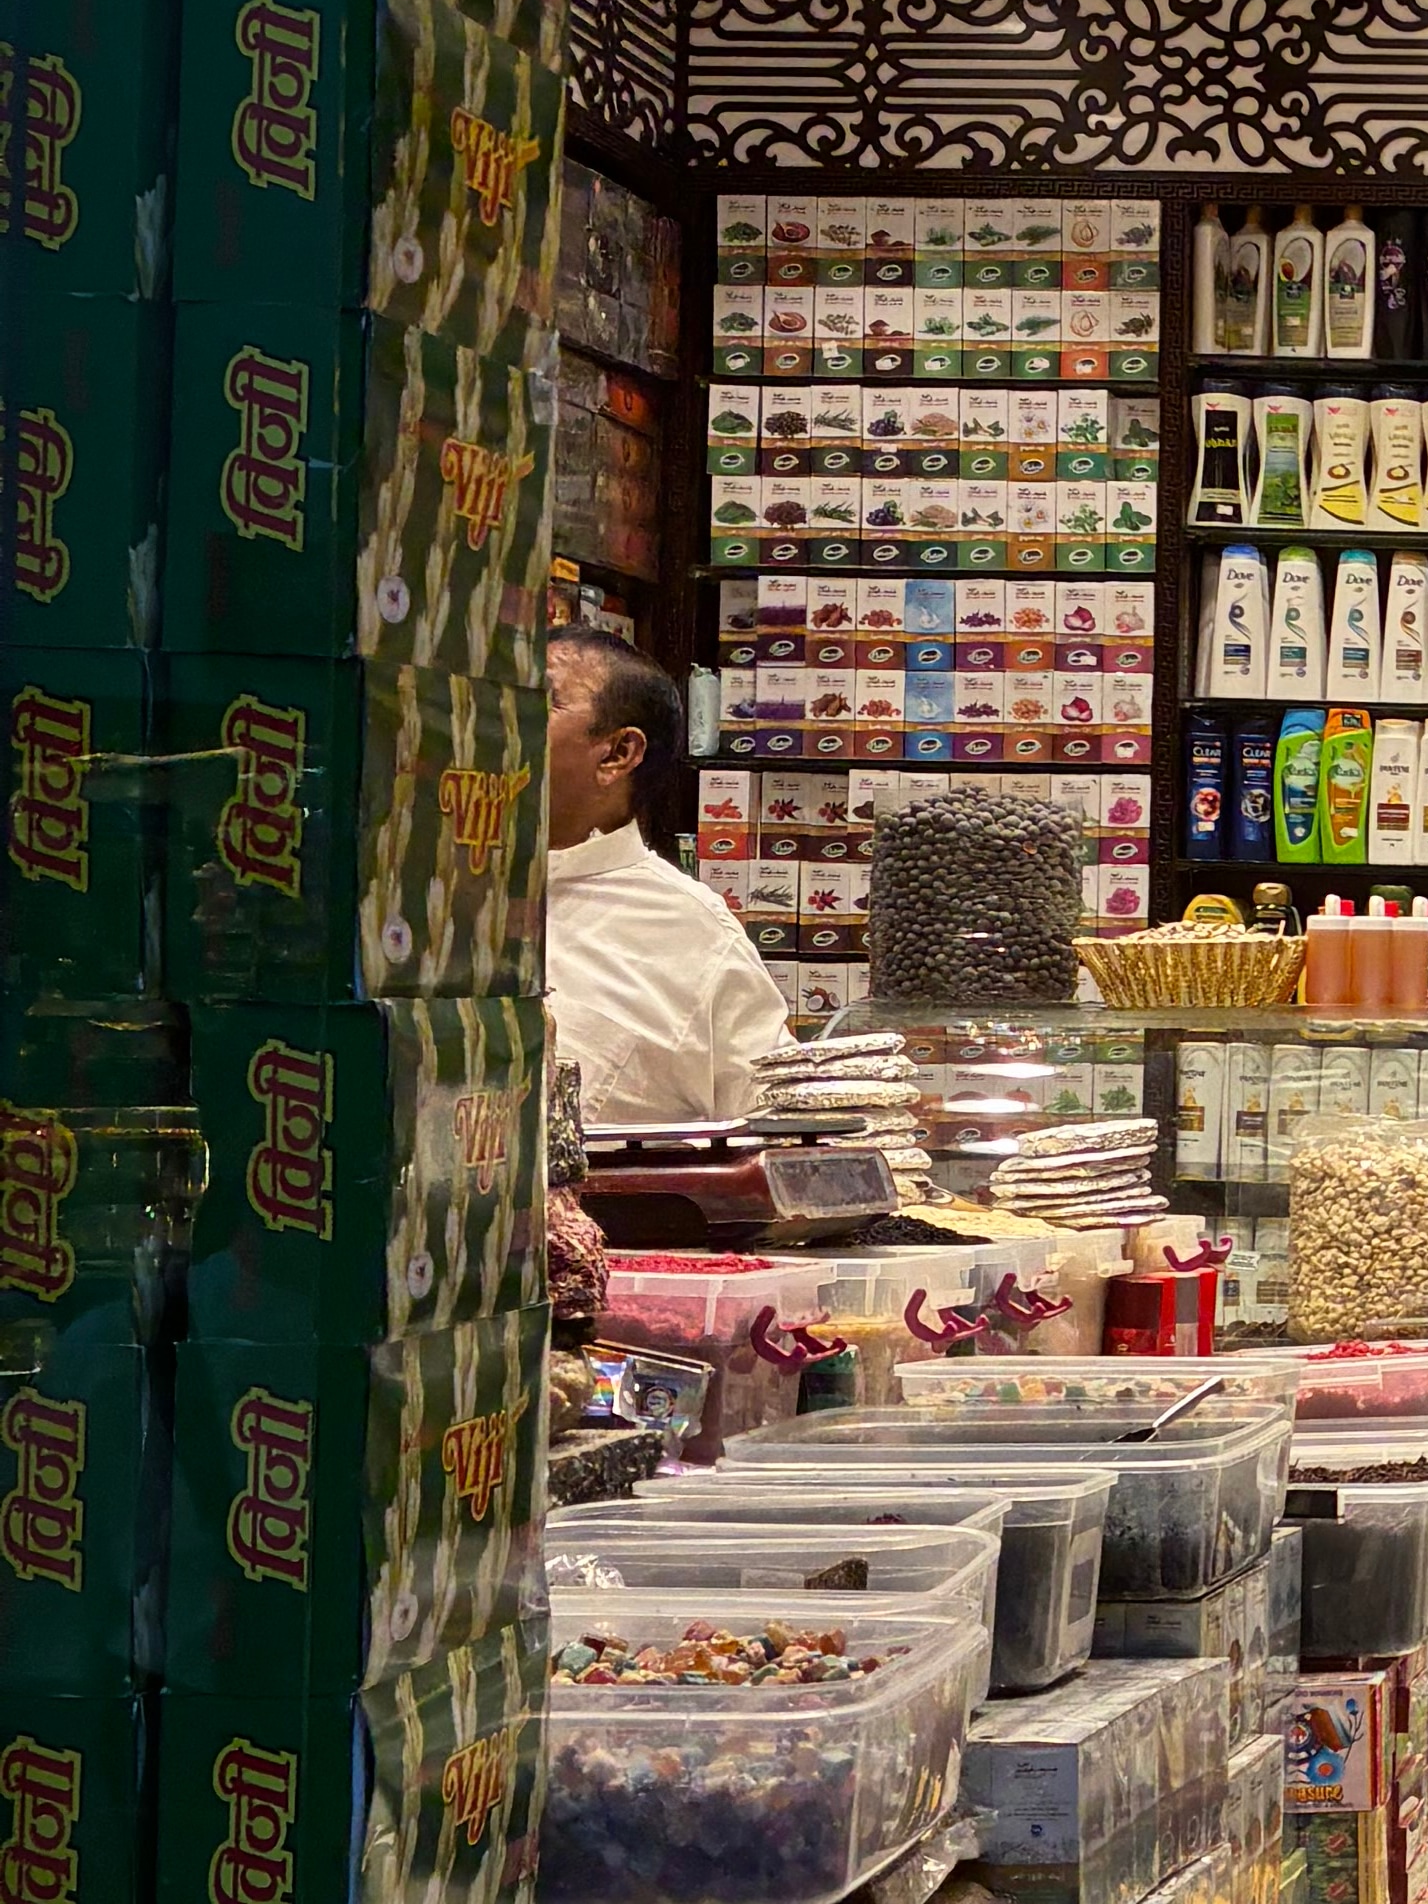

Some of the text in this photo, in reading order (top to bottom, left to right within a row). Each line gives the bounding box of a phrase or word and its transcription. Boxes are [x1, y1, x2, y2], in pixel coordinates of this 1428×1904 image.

[1227, 568, 1254, 582] Dove
[1282, 572, 1310, 584] Dove
[1345, 573, 1373, 586] Dove
[1397, 574, 1424, 588] Dove
